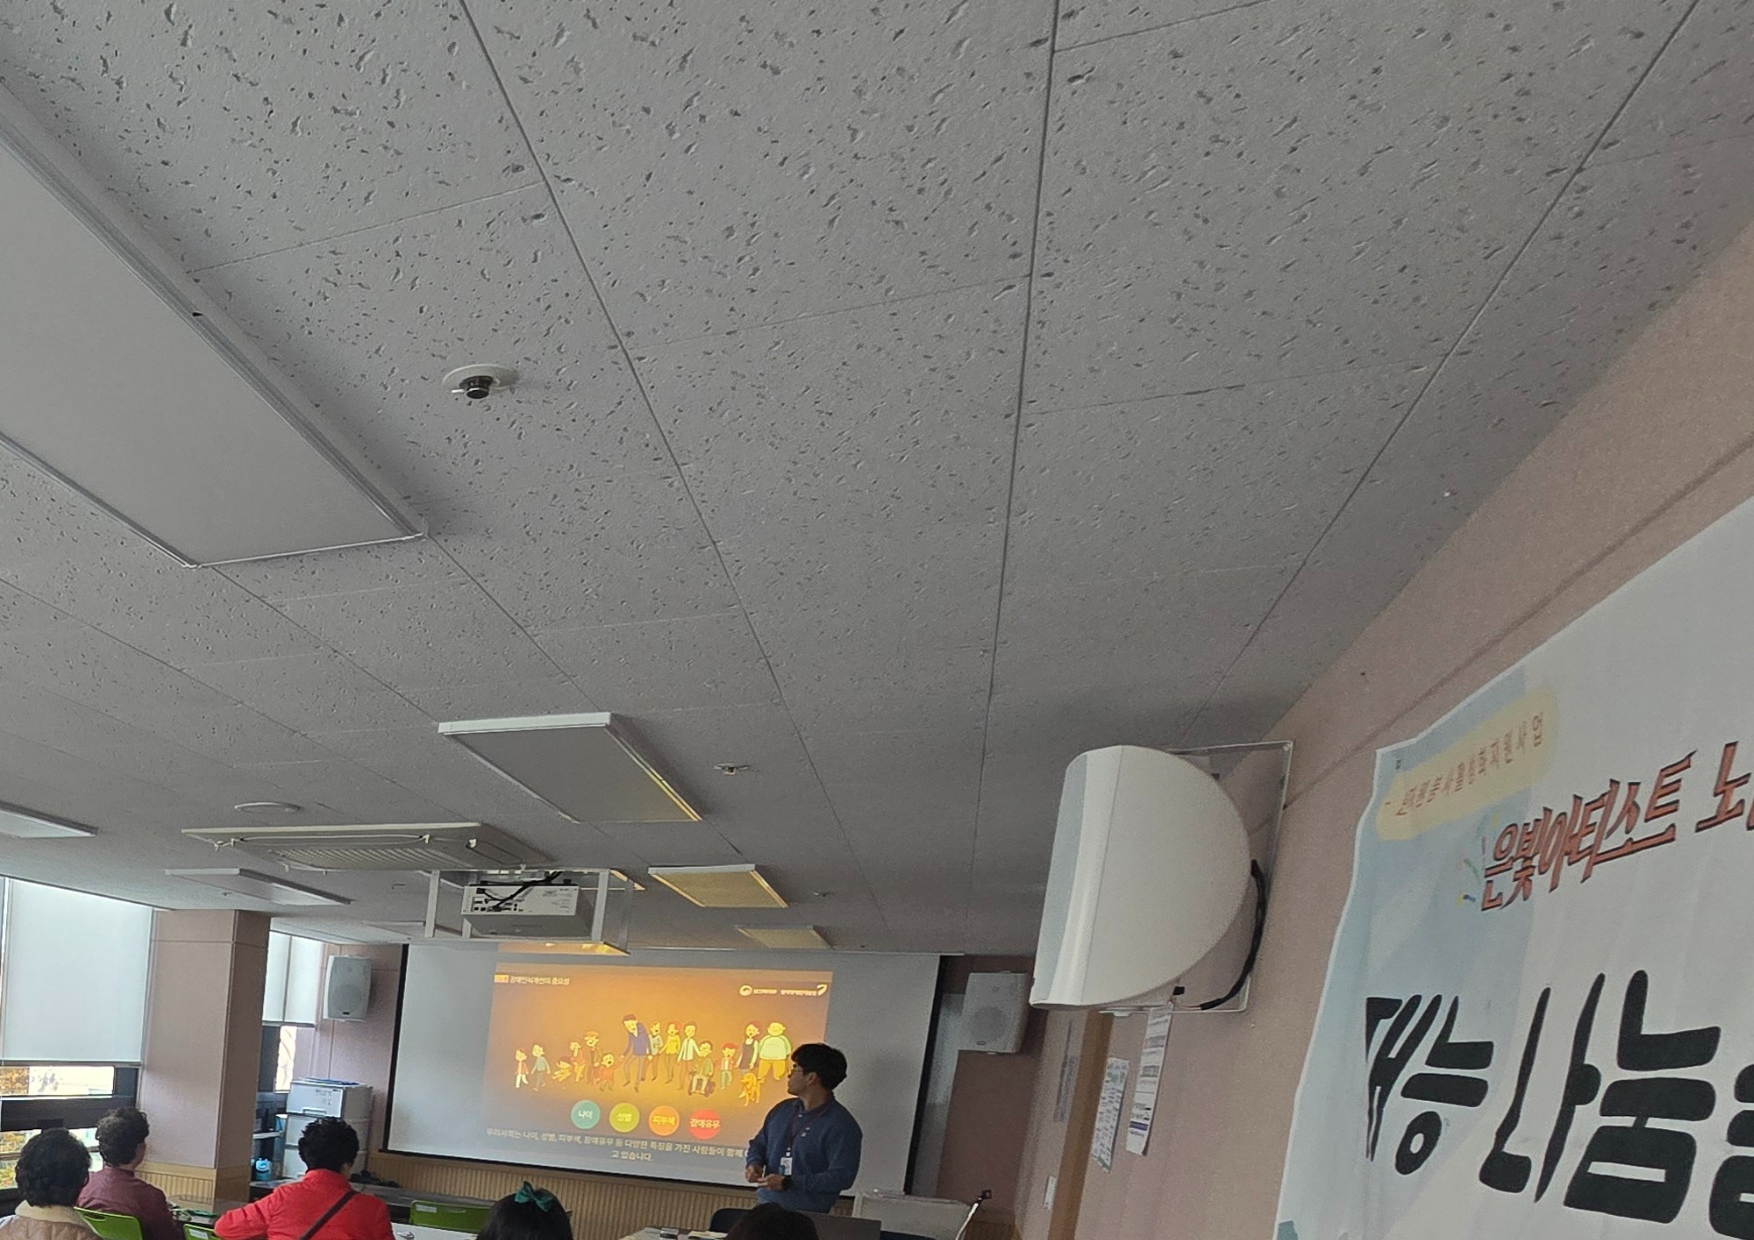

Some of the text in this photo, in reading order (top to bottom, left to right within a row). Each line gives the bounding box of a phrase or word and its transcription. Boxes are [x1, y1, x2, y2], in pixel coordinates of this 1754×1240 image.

[1695, 741, 1754, 832] 노
[578, 1109, 593, 1119] 나이
[674, 1142, 691, 1154] 가진
[611, 1150, 620, 1158] 고
